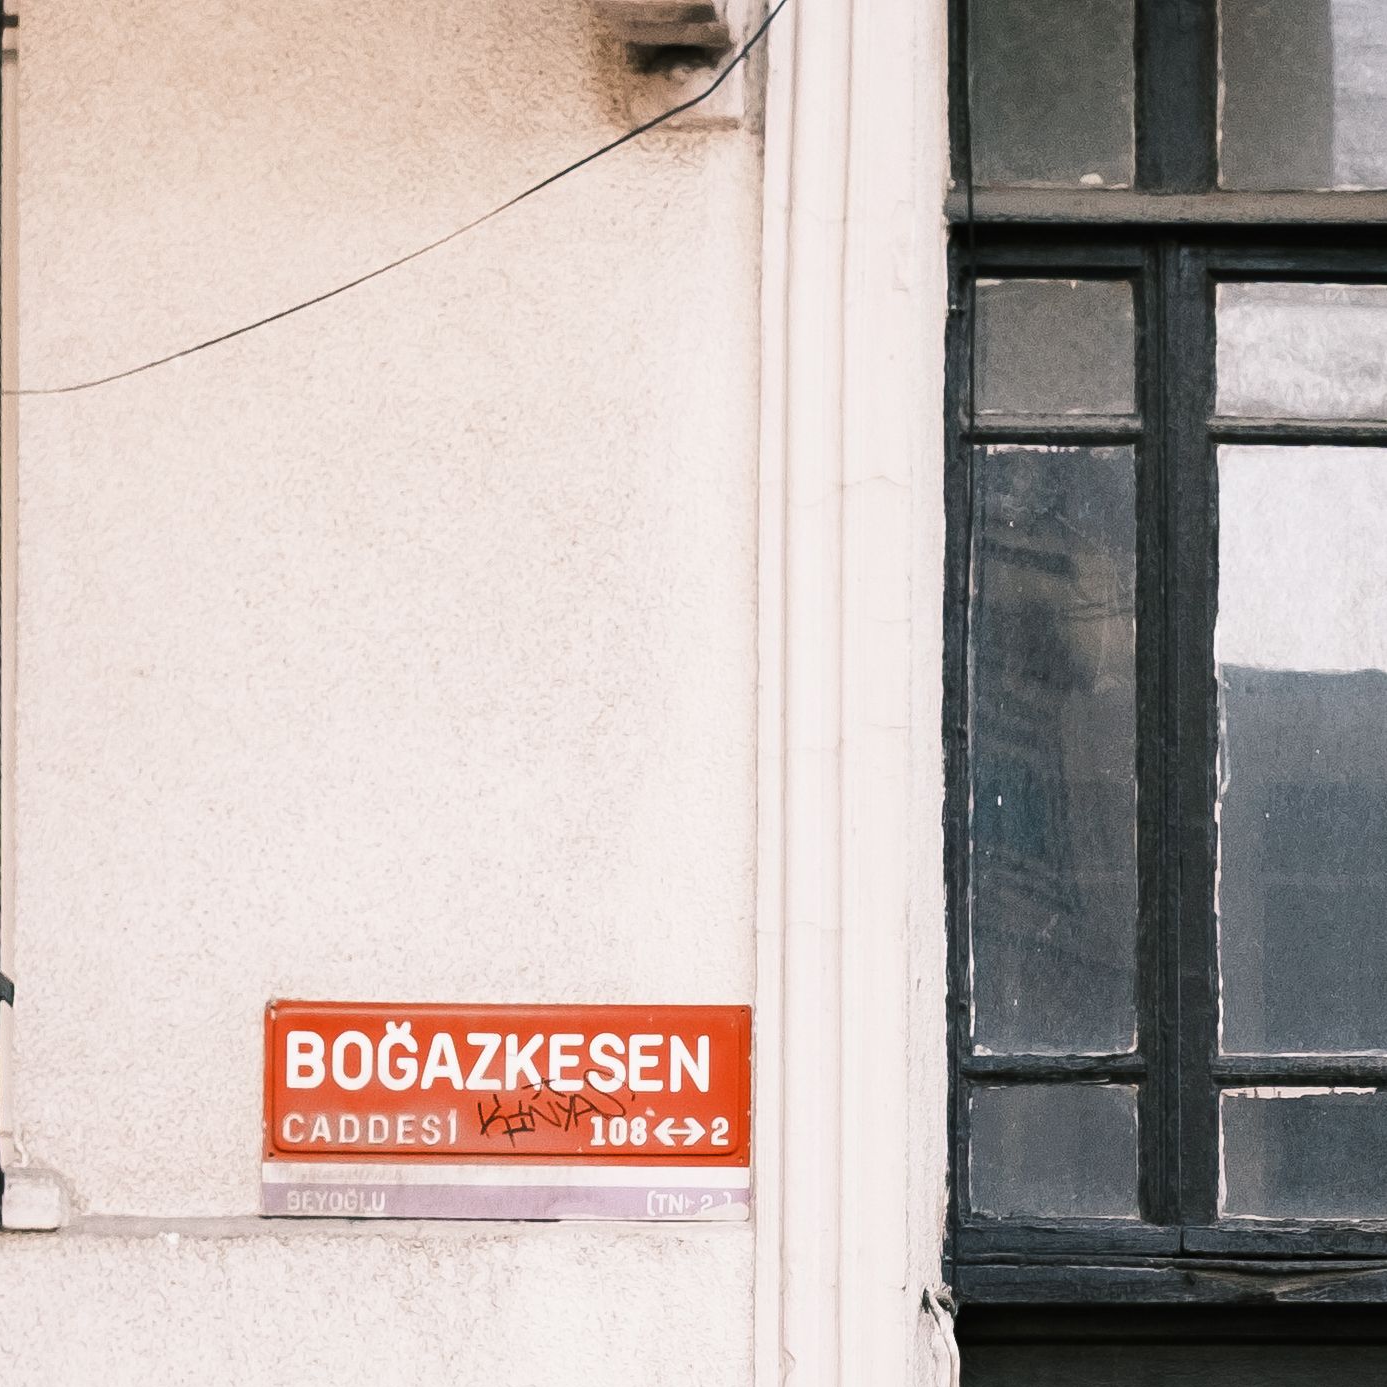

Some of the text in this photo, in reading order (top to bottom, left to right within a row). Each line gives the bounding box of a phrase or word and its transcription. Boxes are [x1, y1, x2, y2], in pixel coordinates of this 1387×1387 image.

[286, 1021, 710, 1093] BOĞAZKESEN
[589, 1116, 730, 1147] 108 2
